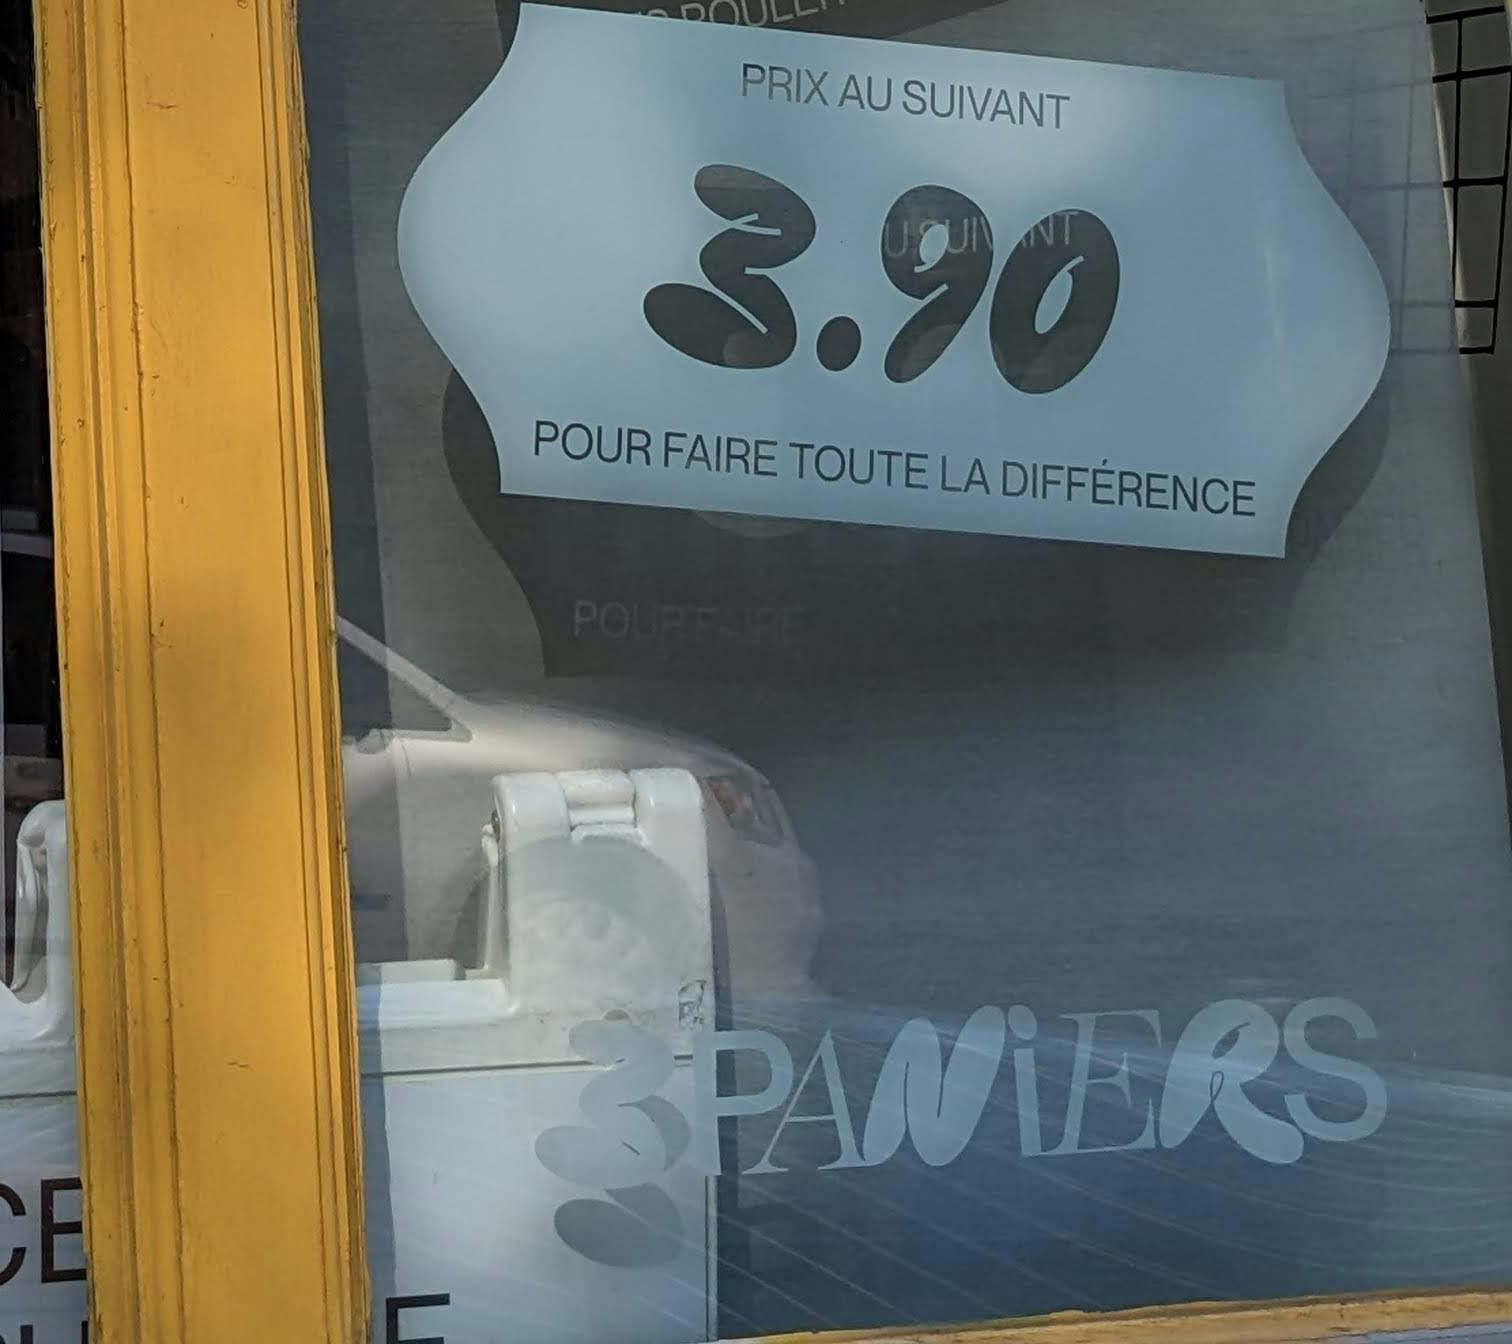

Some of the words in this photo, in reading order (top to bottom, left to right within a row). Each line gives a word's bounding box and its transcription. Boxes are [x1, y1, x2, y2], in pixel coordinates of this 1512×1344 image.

[740, 62, 829, 106] PRIX
[837, 72, 894, 112] AU
[901, 79, 1072, 130] SUIVANT
[642, 163, 1121, 395] 3.90
[533, 419, 653, 470] POUR
[663, 430, 779, 478] FAIRE
[788, 440, 929, 490] TOUTE
[939, 453, 993, 495] LA
[1000, 457, 1257, 518] DIFFÉRENCE
